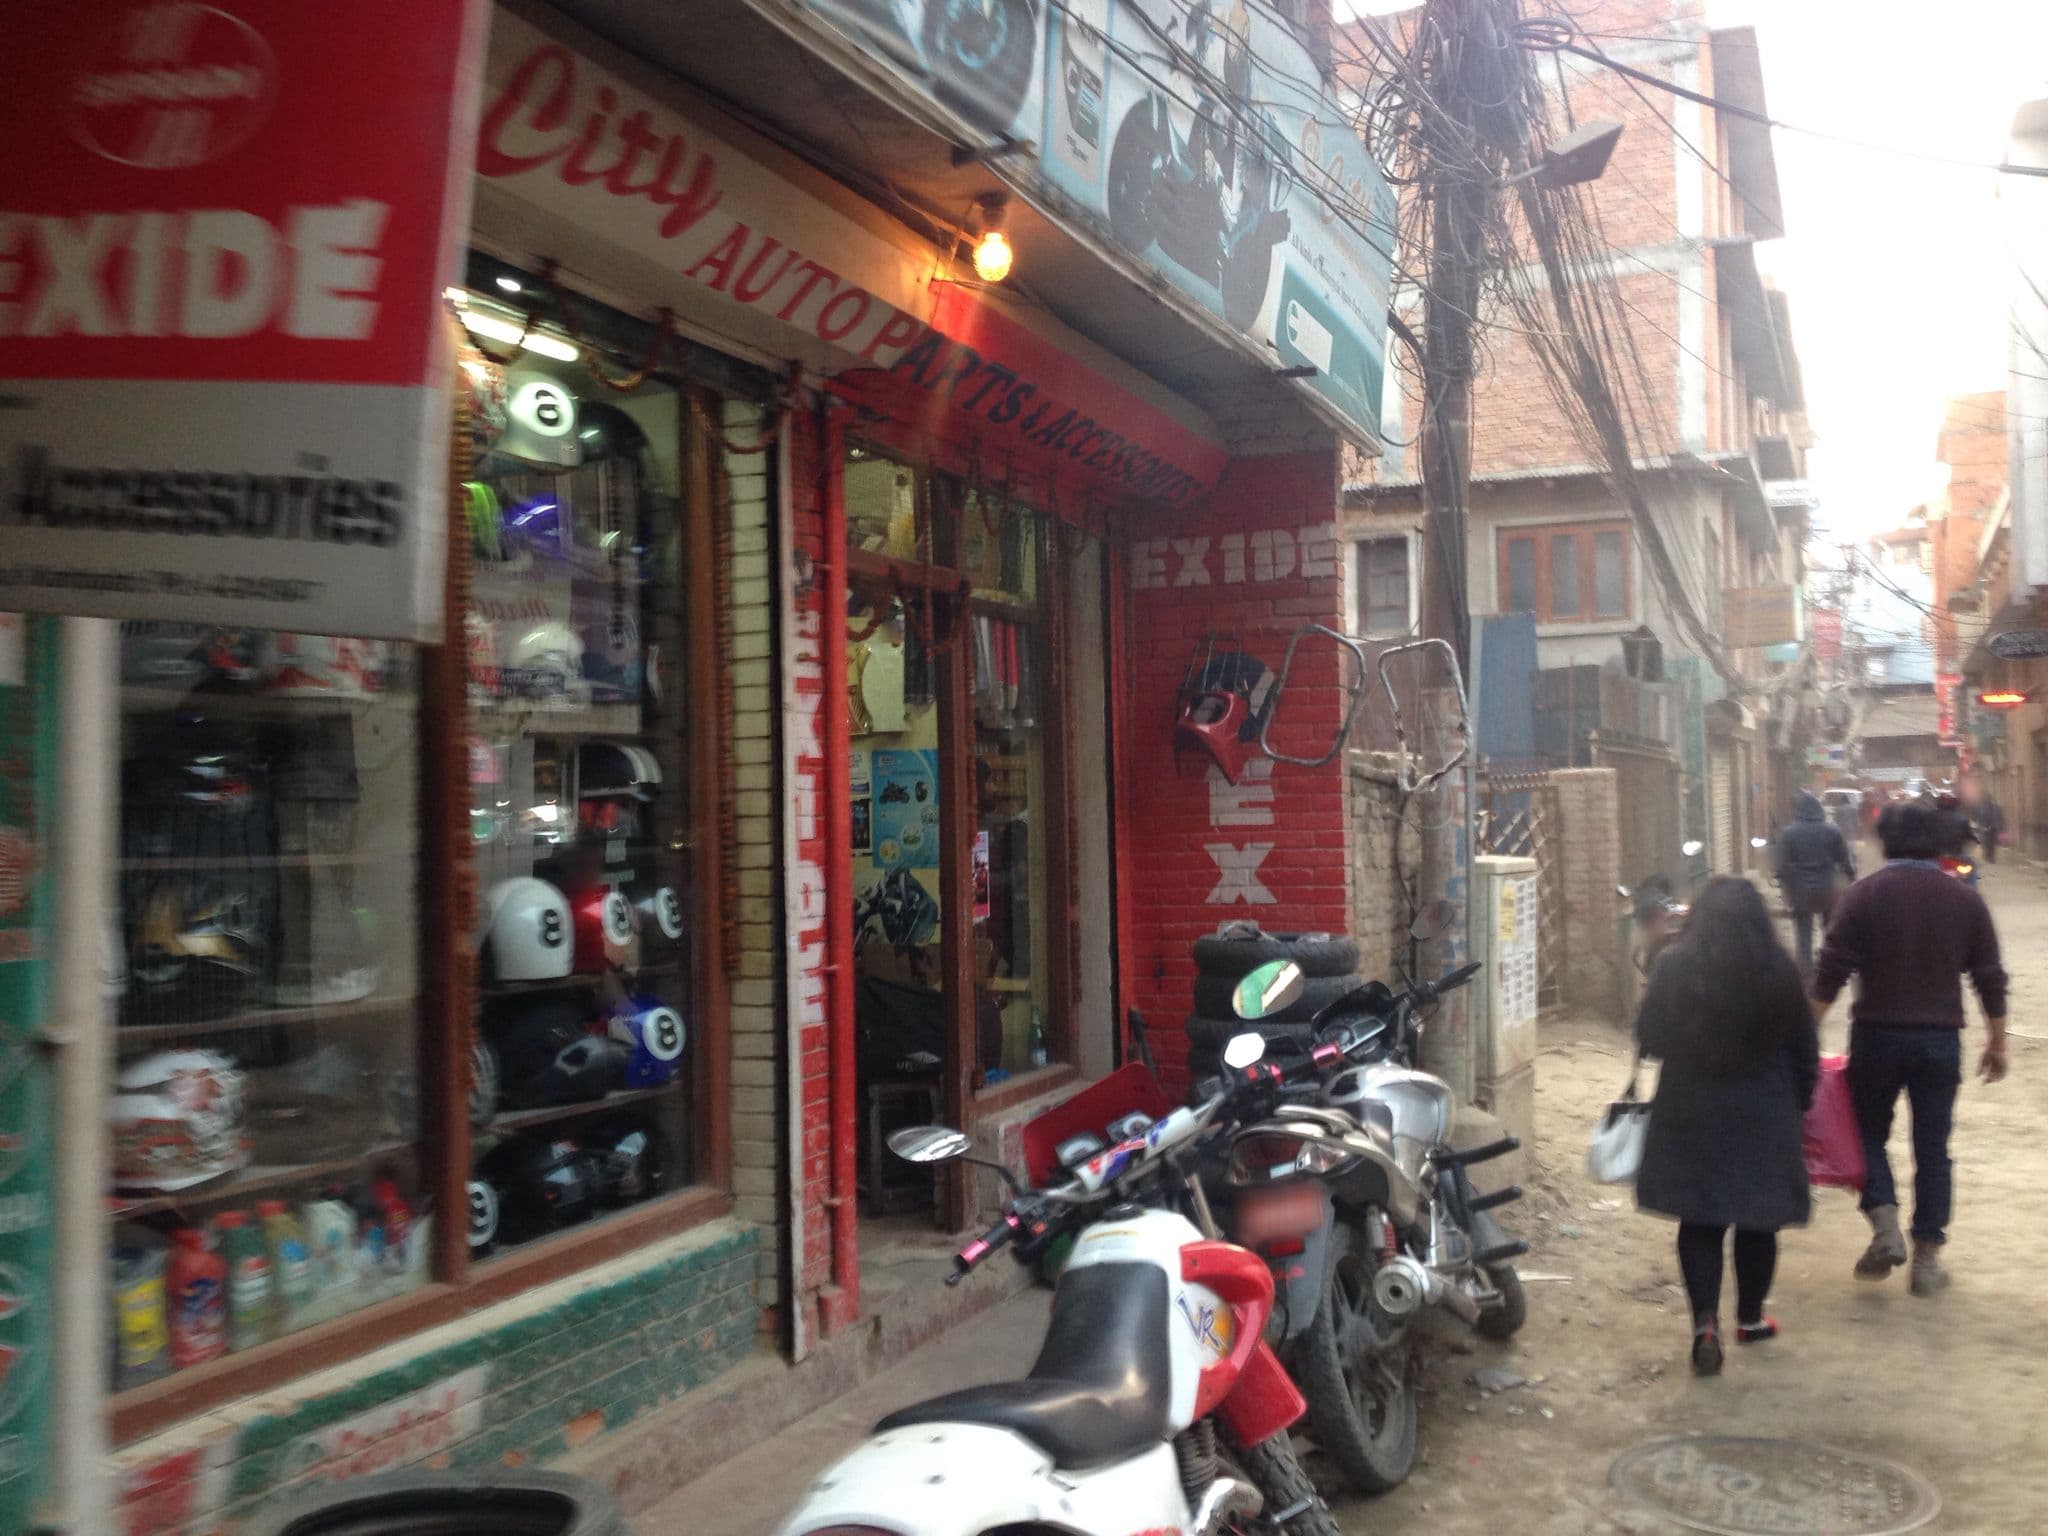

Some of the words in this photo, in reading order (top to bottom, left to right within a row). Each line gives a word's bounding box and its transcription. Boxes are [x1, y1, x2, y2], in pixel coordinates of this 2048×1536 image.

[474, 44, 722, 240] City
[684, 222, 871, 341] AUTO
[859, 309, 1037, 424] PARTS
[656, 1013, 679, 1052] 8
